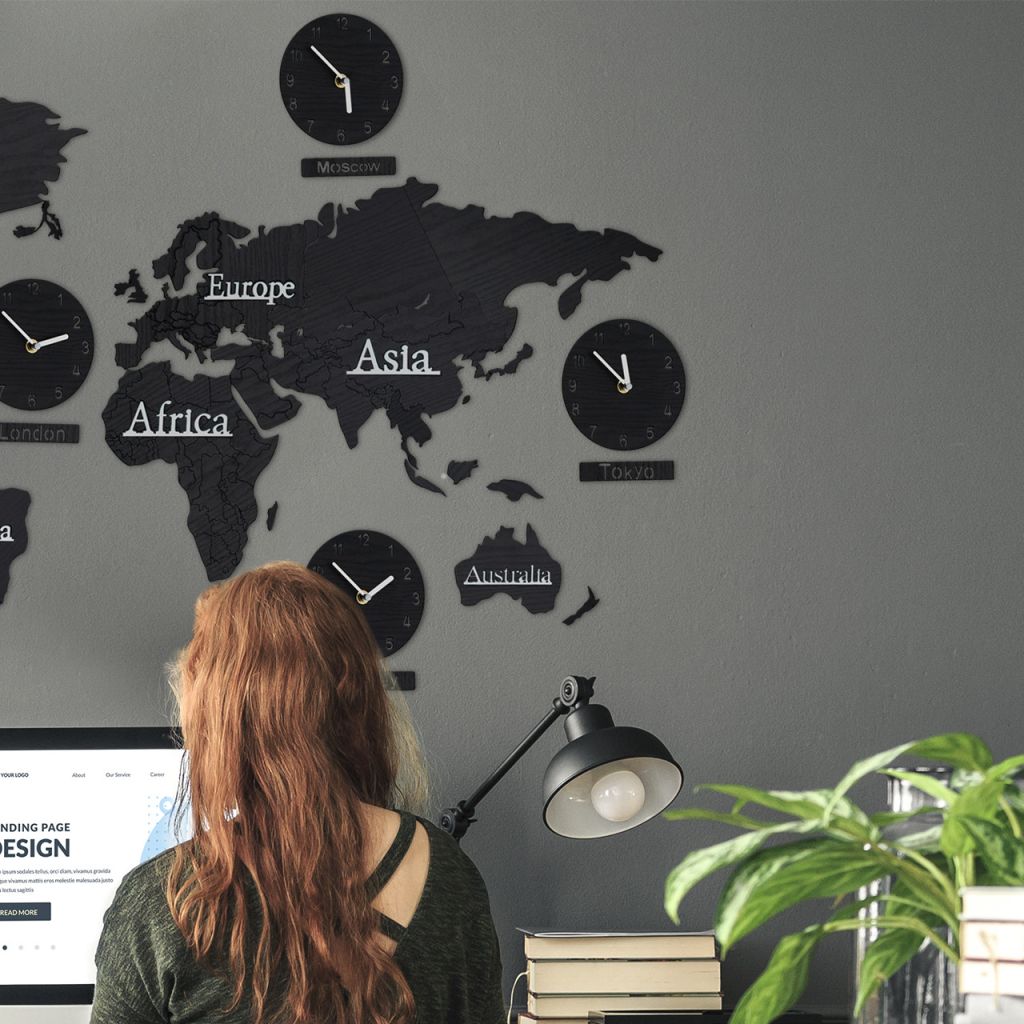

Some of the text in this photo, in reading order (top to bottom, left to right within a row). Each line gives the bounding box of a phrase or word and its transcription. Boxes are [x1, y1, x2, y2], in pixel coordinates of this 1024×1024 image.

[337, 17, 348, 30] 12
[312, 27, 321, 39] 11
[367, 28, 372, 40] 1
[291, 51, 302, 63] 10
[382, 51, 390, 63] 2
[287, 74, 294, 87] 9
[391, 76, 399, 88] 3
[290, 98, 297, 110] 8
[382, 99, 389, 112] 4
[307, 120, 314, 133] 7
[337, 129, 345, 143] 6
[317, 161, 381, 173] Moscow
[28, 282, 39, 295] 12
[204, 273, 295, 305] Europe
[3, 292, 13, 304] 11
[58, 294, 63, 305] 1
[73, 316, 80, 329] 2
[620, 323, 630, 336] 12
[595, 332, 605, 344] 11
[649, 334, 655, 345] 1
[82, 341, 89, 354] 3
[346, 338, 440, 375] Asia
[574, 355, 584, 368] 10
[665, 356, 672, 369] 2
[73, 364, 80, 375] 4
[0, 386, 5, 398] 7
[569, 380, 576, 392] 9
[673, 381, 681, 394] 3
[28, 395, 36, 408] 6
[572, 403, 580, 416] 8
[664, 402, 672, 416] 4
[122, 400, 233, 436] Africa
[0, 425, 66, 441] London
[590, 426, 597, 438] 7
[620, 434, 627, 448] 6
[598, 463, 654, 480] Tokyo
[358, 533, 369, 546] 12
[334, 544, 343, 555] 11
[387, 545, 393, 556] 1
[404, 568, 411, 580] 2
[464, 565, 552, 585] Australia
[412, 593, 420, 605] 3
[403, 616, 411, 628] 4
[41, 822, 71, 832] PAGE
